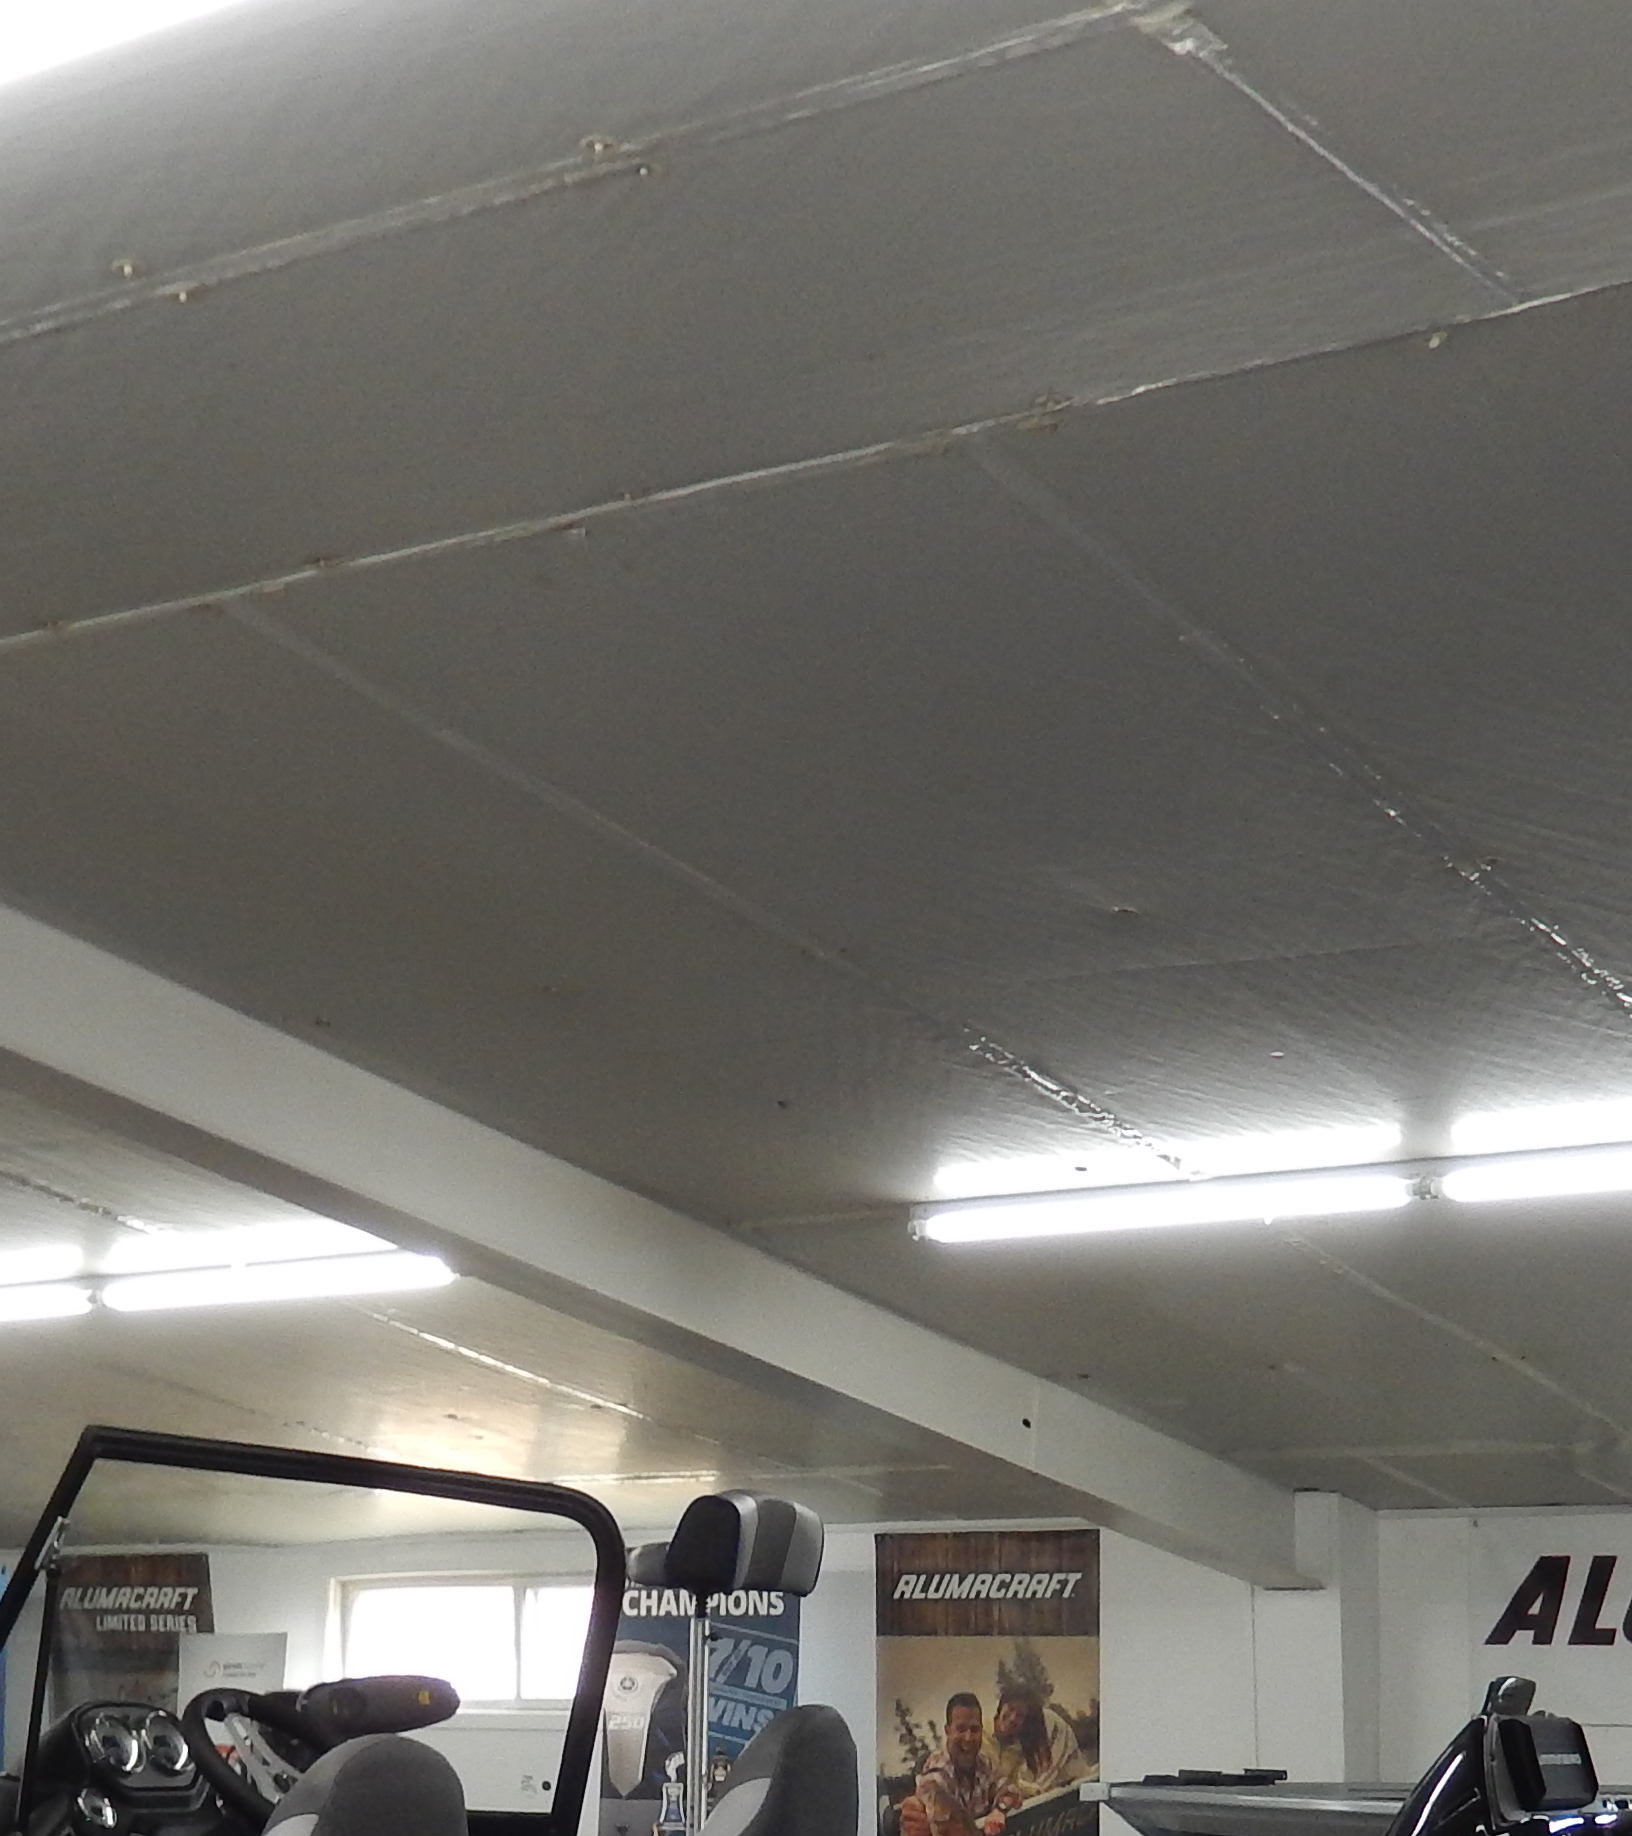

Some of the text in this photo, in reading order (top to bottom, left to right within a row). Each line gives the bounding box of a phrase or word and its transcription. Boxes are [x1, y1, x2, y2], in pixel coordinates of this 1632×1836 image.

[893, 1572, 1082, 1600] ALUMACRAFT
[60, 1586, 198, 1611] ALUMACRAFT
[96, 1614, 197, 1633] LIMITED SERIES
[608, 1714, 645, 1731] 250
